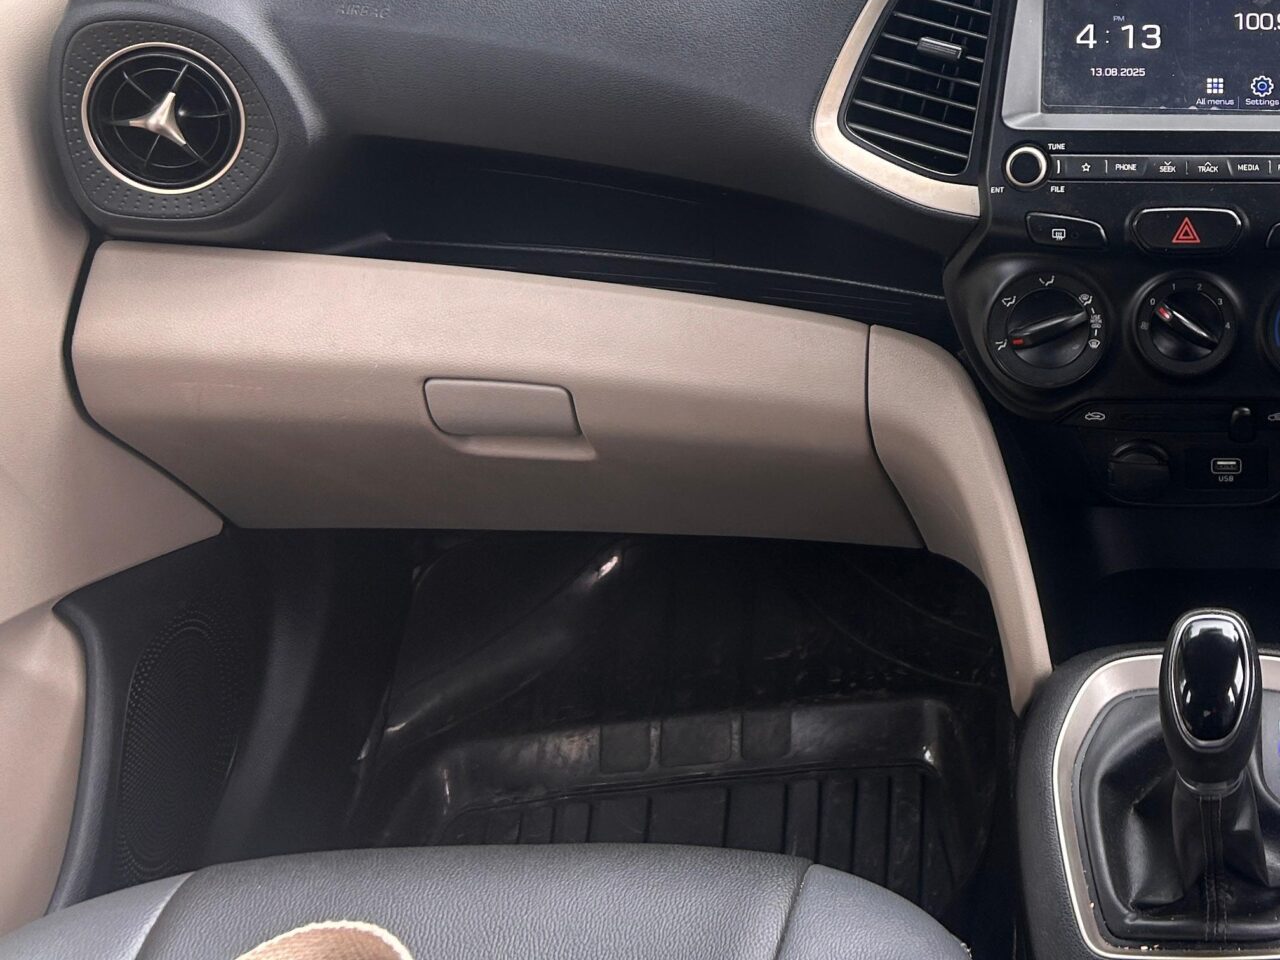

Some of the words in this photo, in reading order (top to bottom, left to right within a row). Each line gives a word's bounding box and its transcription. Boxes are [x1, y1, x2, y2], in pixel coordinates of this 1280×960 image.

[337, 4, 390, 19] AIRBAG
[1090, 68, 1146, 77] 13.08.2025
[1245, 98, 1280, 107] Settings
